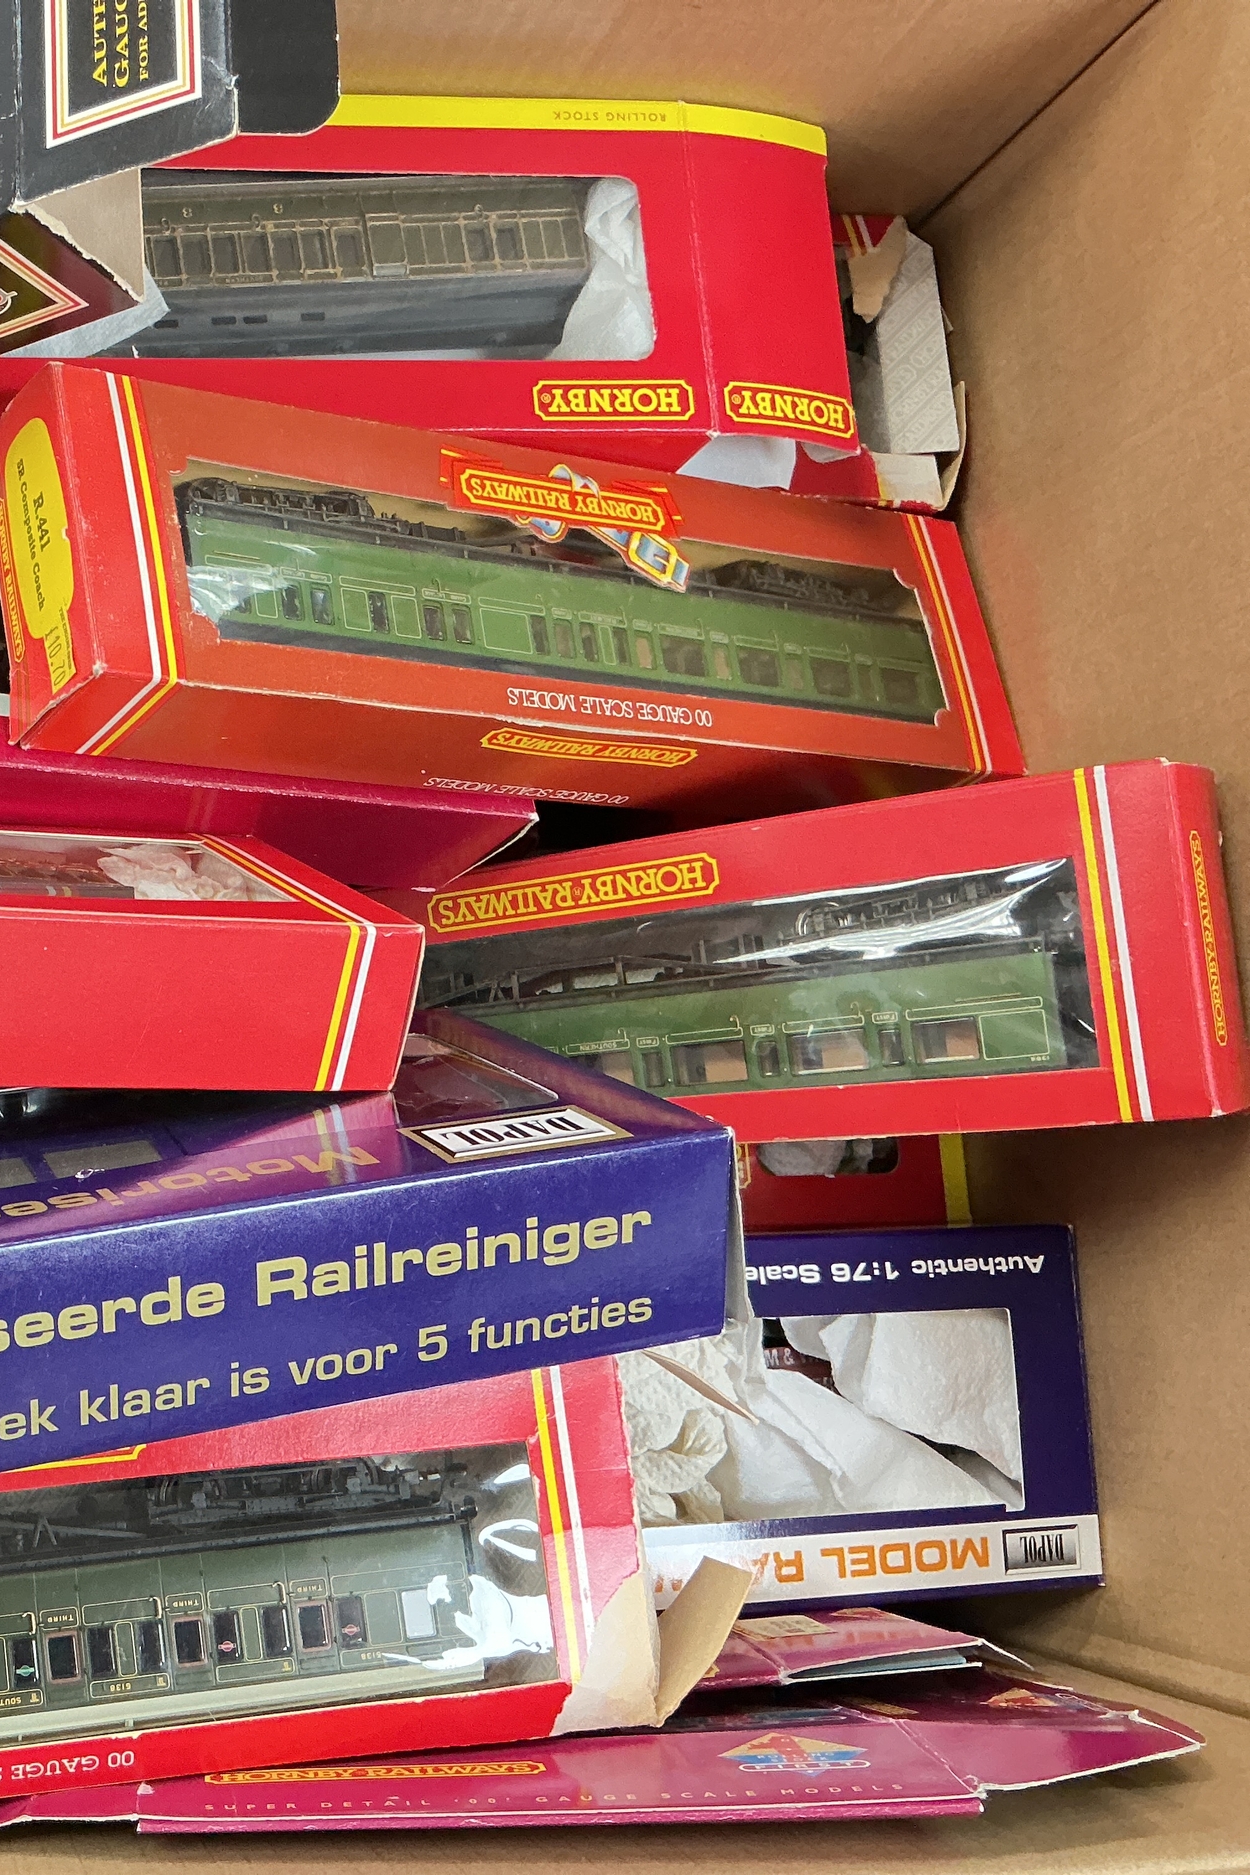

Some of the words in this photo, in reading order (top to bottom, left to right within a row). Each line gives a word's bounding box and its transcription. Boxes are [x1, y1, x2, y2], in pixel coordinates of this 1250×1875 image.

[138, 34, 149, 82] FOR
[553, 110, 600, 122] STOCK
[607, 110, 668, 123] ROLLING
[16, 459, 25, 481] SR
[470, 479, 572, 511] RAILWAYS
[20, 482, 37, 560] Composite
[33, 490, 51, 552] R.441
[576, 494, 657, 524] HORNBY
[32, 562, 46, 613] Coach
[5, 576, 23, 660] RAILWAYS
[507, 687, 577, 713] MODELS
[580, 695, 634, 717] SCALE
[637, 703, 693, 725] GAUGE
[494, 731, 603, 755] RAILWAYS
[601, 745, 687, 764] HORNBY
[423, 776, 494, 794] MODELS
[496, 784, 550, 799] SCALE
[547, 789, 609, 804] GAUGE
[439, 881, 573, 925] RAILWAYS
[1191, 839, 1214, 944] RAILWAYS
[1205, 947, 1227, 1037] HORNBY
[579, 1040, 618, 1052] SOUTHERN
[437, 1110, 585, 1143] DAPOL
[255, 1210, 653, 1308] Railreiniger
[911, 1253, 1046, 1276] Authentic
[831, 1261, 900, 1282] 1:76
[78, 1376, 212, 1427] klaar
[230, 1360, 271, 1396] is
[289, 1341, 399, 1387] voor
[418, 1324, 449, 1364] 5
[467, 1294, 654, 1357] functies
[821, 1536, 990, 1578] MODEL
[1019, 1532, 1066, 1564] DAPOL
[296, 1583, 323, 1595] THIRD
[170, 1597, 200, 1609] THIRD
[47, 1612, 74, 1625] THIRD
[13, 1756, 100, 1780] GAUGE
[222, 1769, 357, 1780] HORNBY
[371, 1761, 543, 1777] RAILWAYS
[753, 1762, 855, 1770] FIRST
[205, 1803, 298, 1811] SUPER
[320, 1799, 430, 1809] DETAIL
[534, 1793, 637, 1803] GAUGE
[660, 1789, 756, 1798] SCALE
[780, 1782, 904, 1795] MODELS
